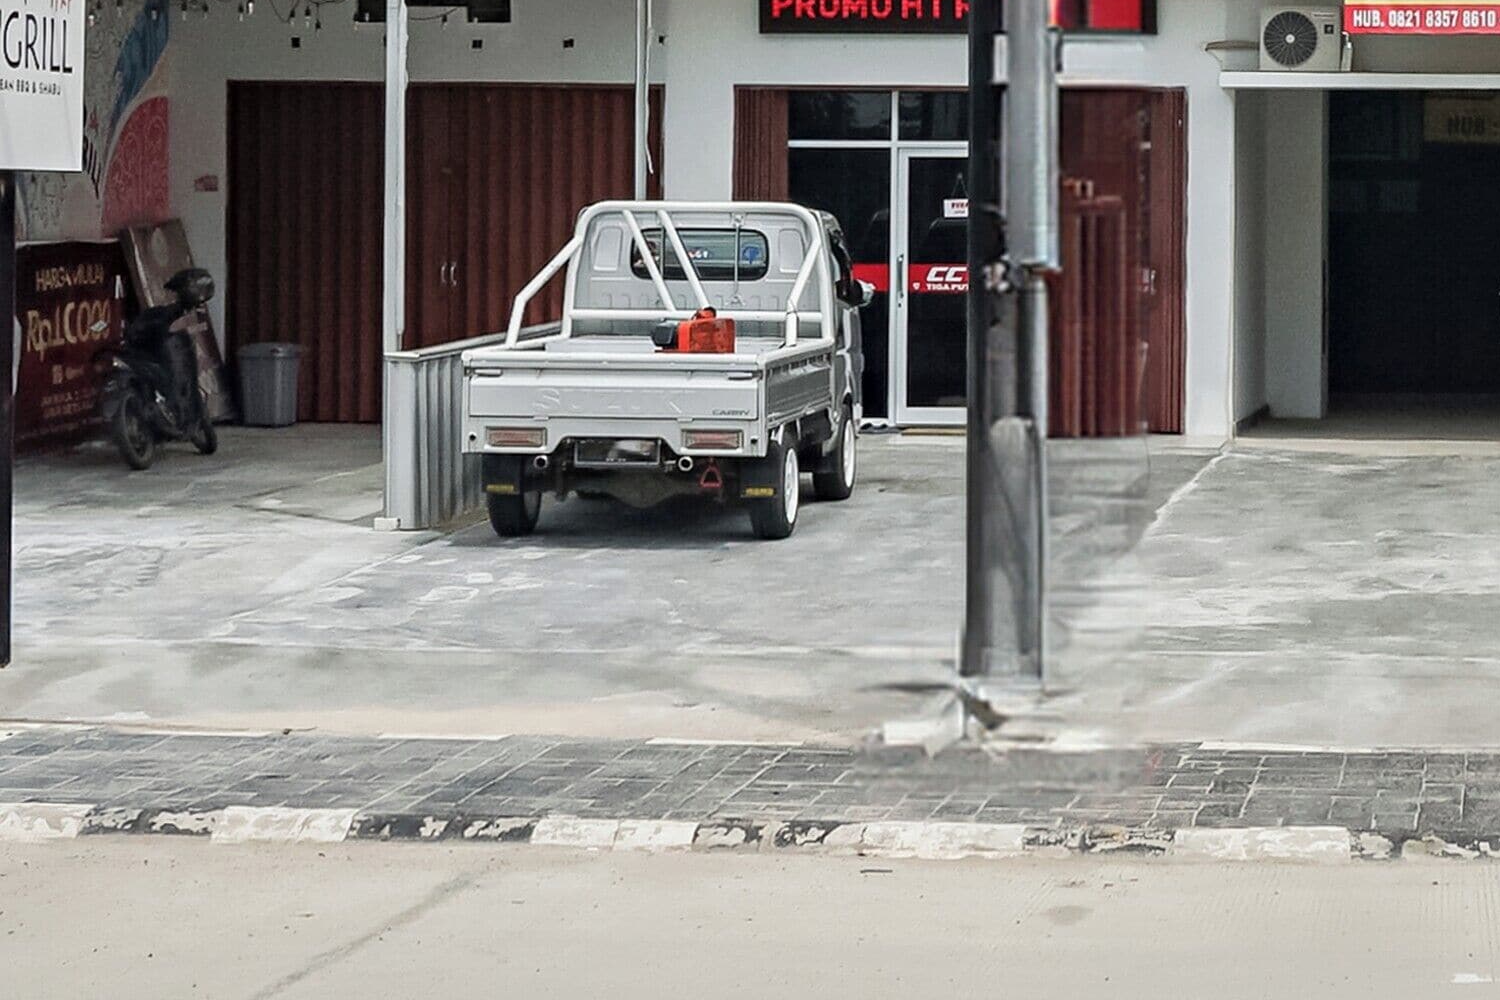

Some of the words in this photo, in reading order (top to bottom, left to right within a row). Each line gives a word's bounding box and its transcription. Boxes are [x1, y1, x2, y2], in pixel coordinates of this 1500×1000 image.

[1352, 9, 1386, 28] HUB.
[1388, 9, 1421, 28] 0821
[1425, 9, 1459, 28] 8357
[1462, 10, 1497, 28] 8610
[0, 10, 73, 74] GRILL
